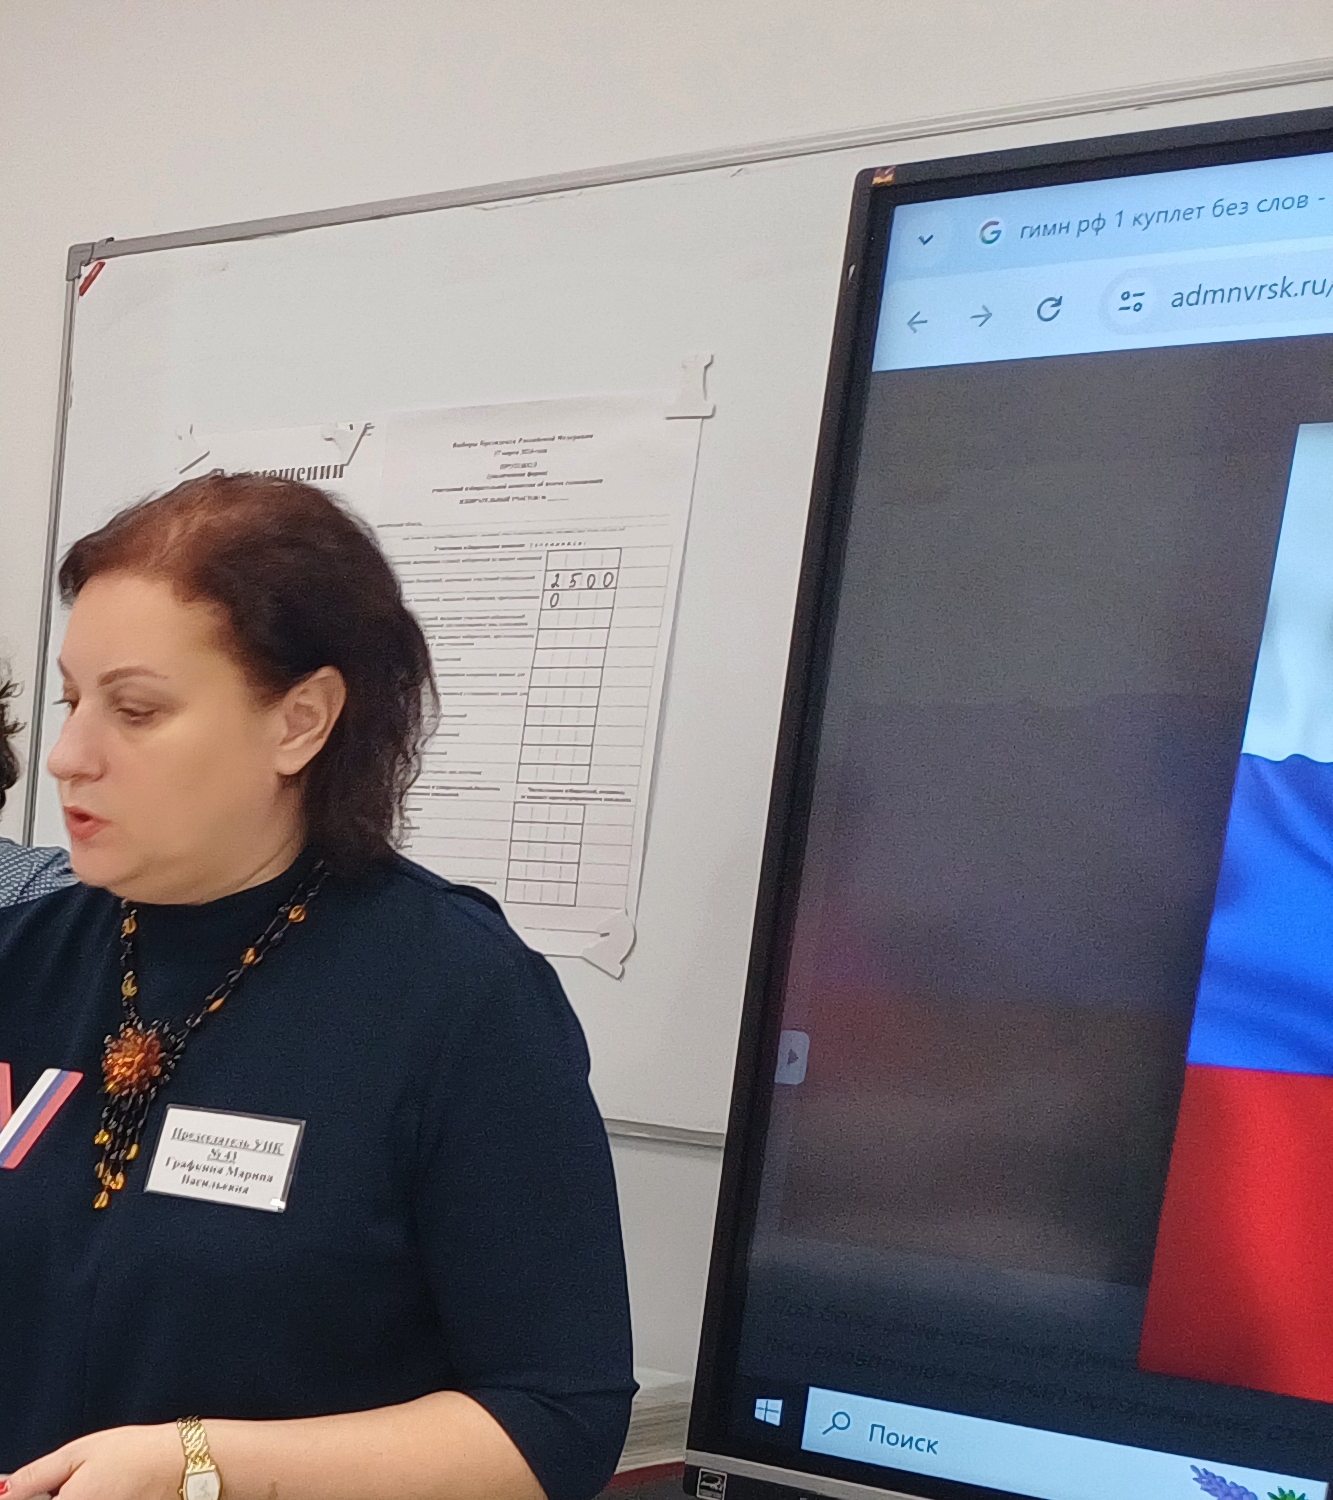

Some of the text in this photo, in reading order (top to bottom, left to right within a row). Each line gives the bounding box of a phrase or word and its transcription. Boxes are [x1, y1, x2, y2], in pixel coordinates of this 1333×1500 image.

[1019, 219, 1071, 240] гимн
[1076, 211, 1106, 238] рф
[1115, 209, 1124, 229] 1
[1132, 203, 1206, 231] куплет
[1212, 197, 1250, 218] без
[1256, 192, 1309, 213] слов
[868, 1423, 939, 1456] Поиск
